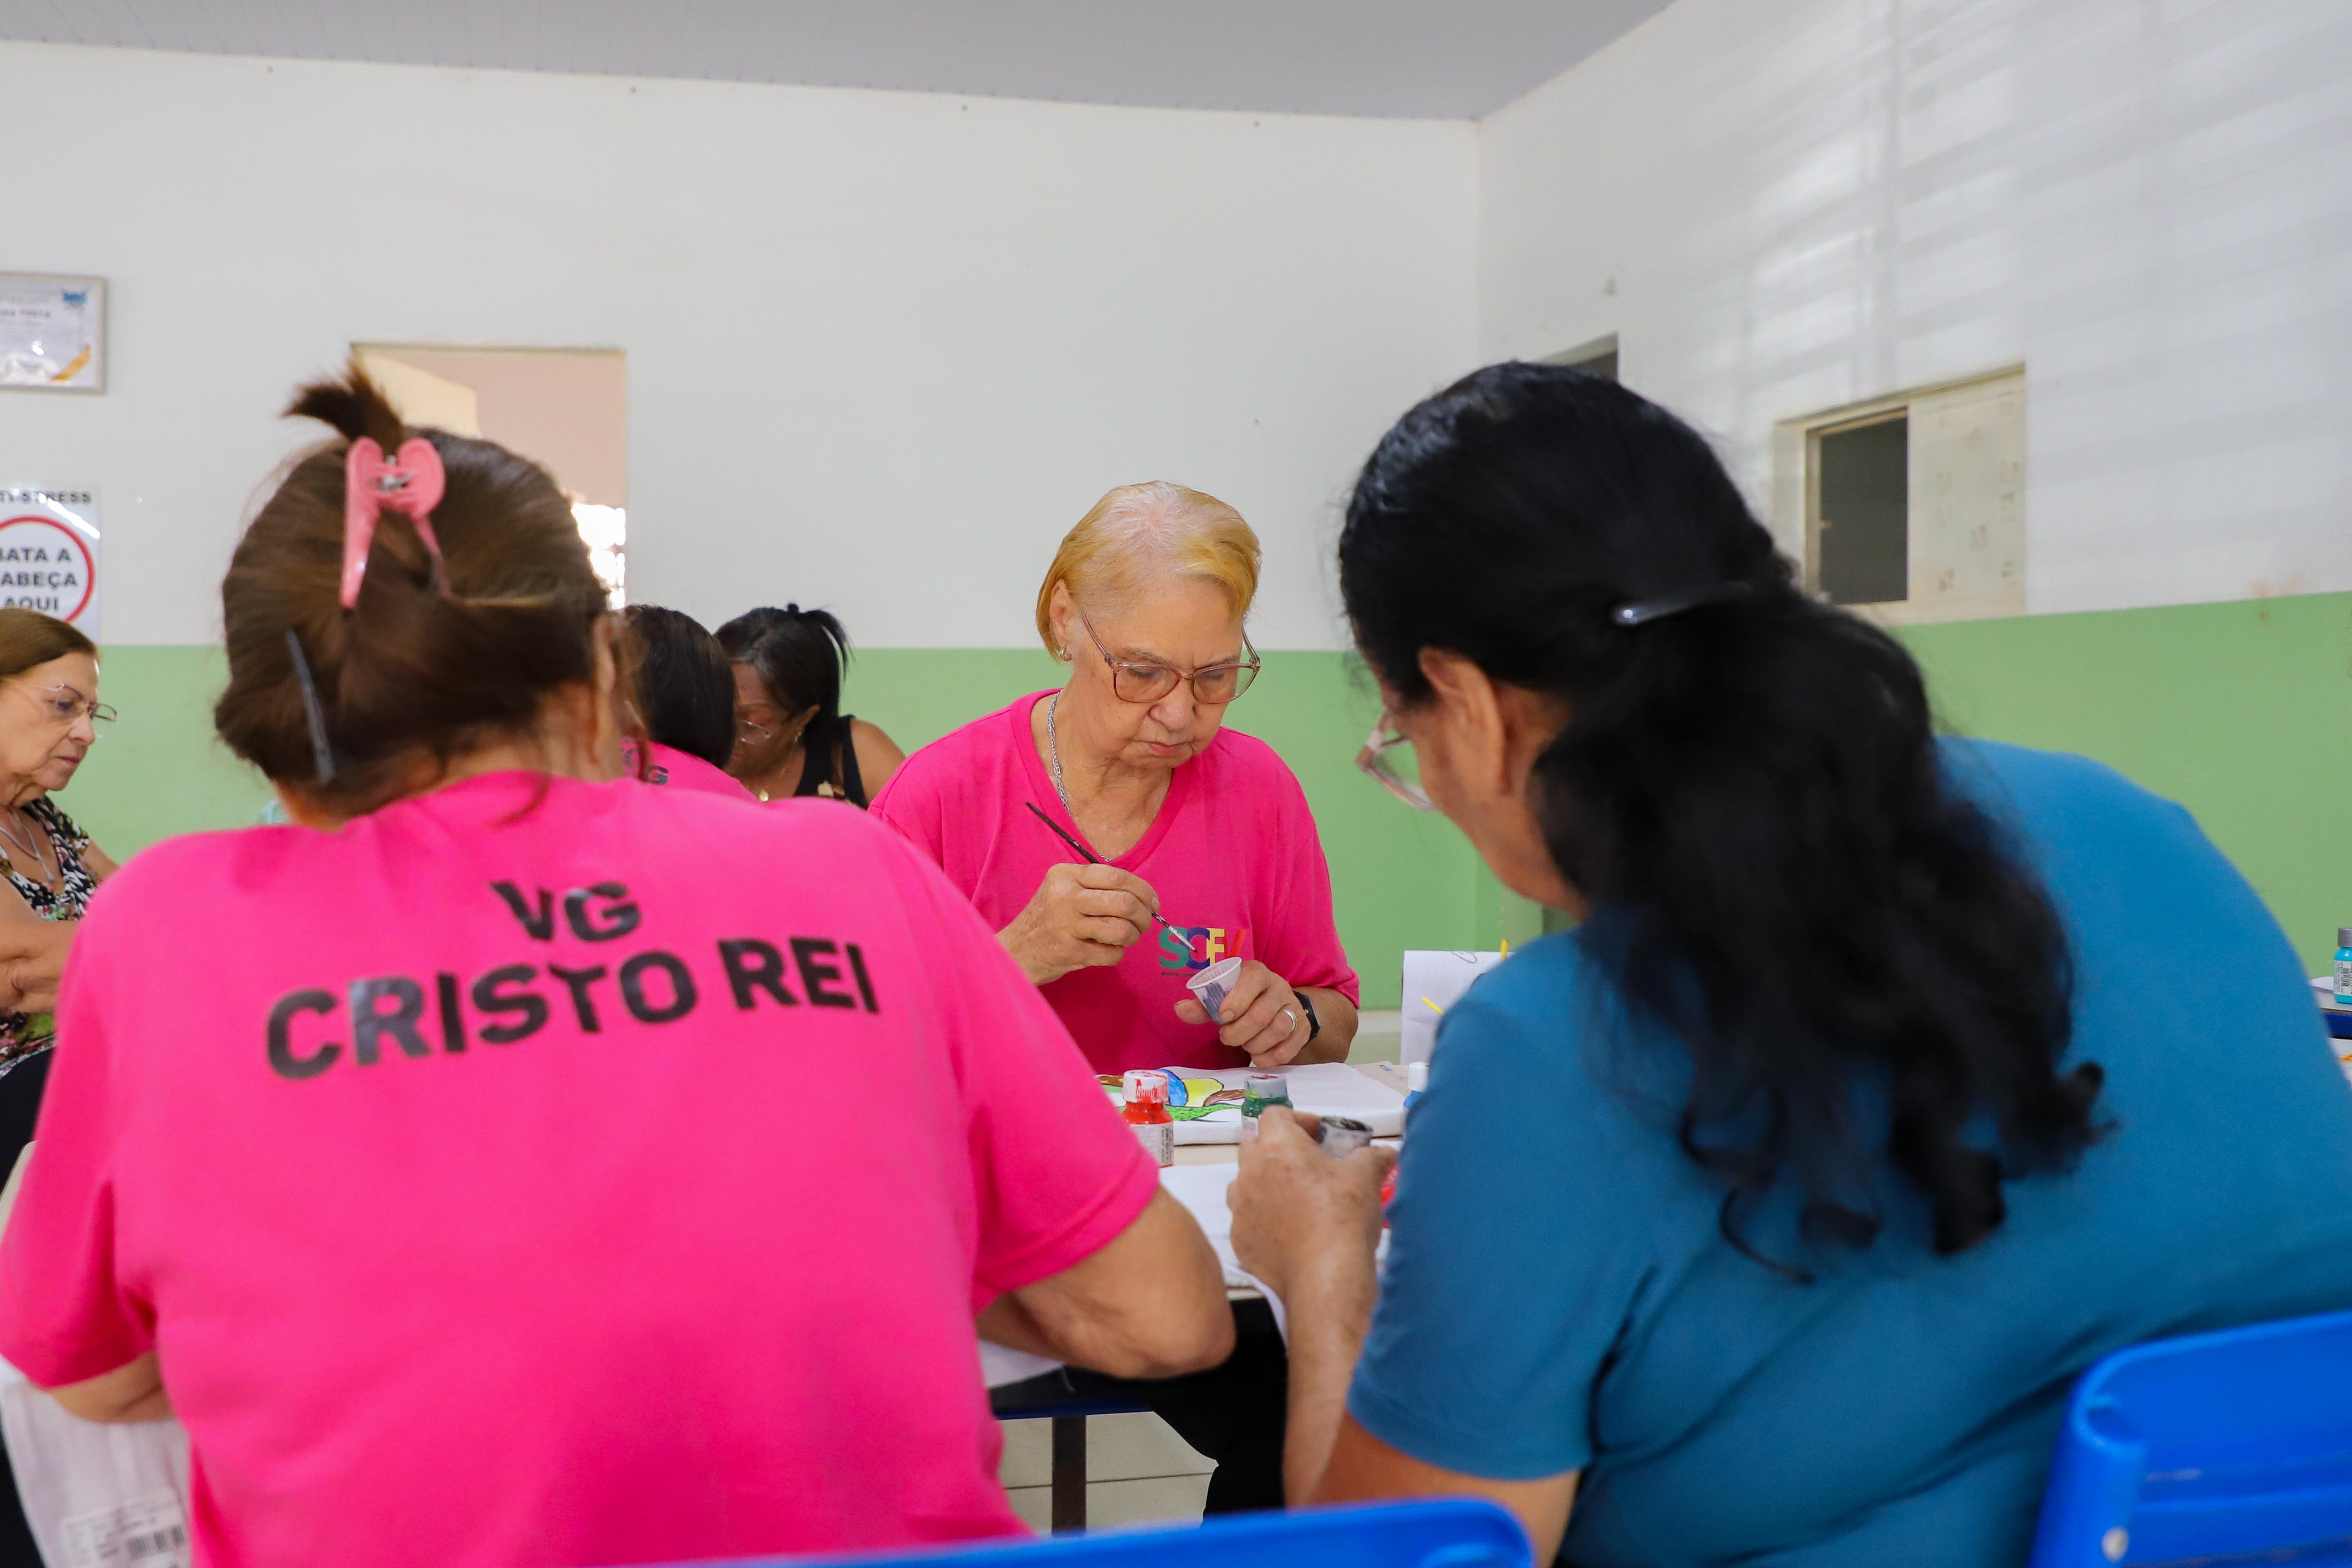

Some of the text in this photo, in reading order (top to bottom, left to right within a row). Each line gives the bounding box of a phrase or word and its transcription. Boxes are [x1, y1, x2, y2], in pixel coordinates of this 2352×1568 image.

[57, 547, 71, 561] A
[1, 572, 77, 590] ABEÇA
[5, 596, 59, 610] AQUI
[490, 882, 641, 943] VG
[1159, 927, 1247, 970] SCFV
[267, 936, 879, 1079] CRISTO REI
